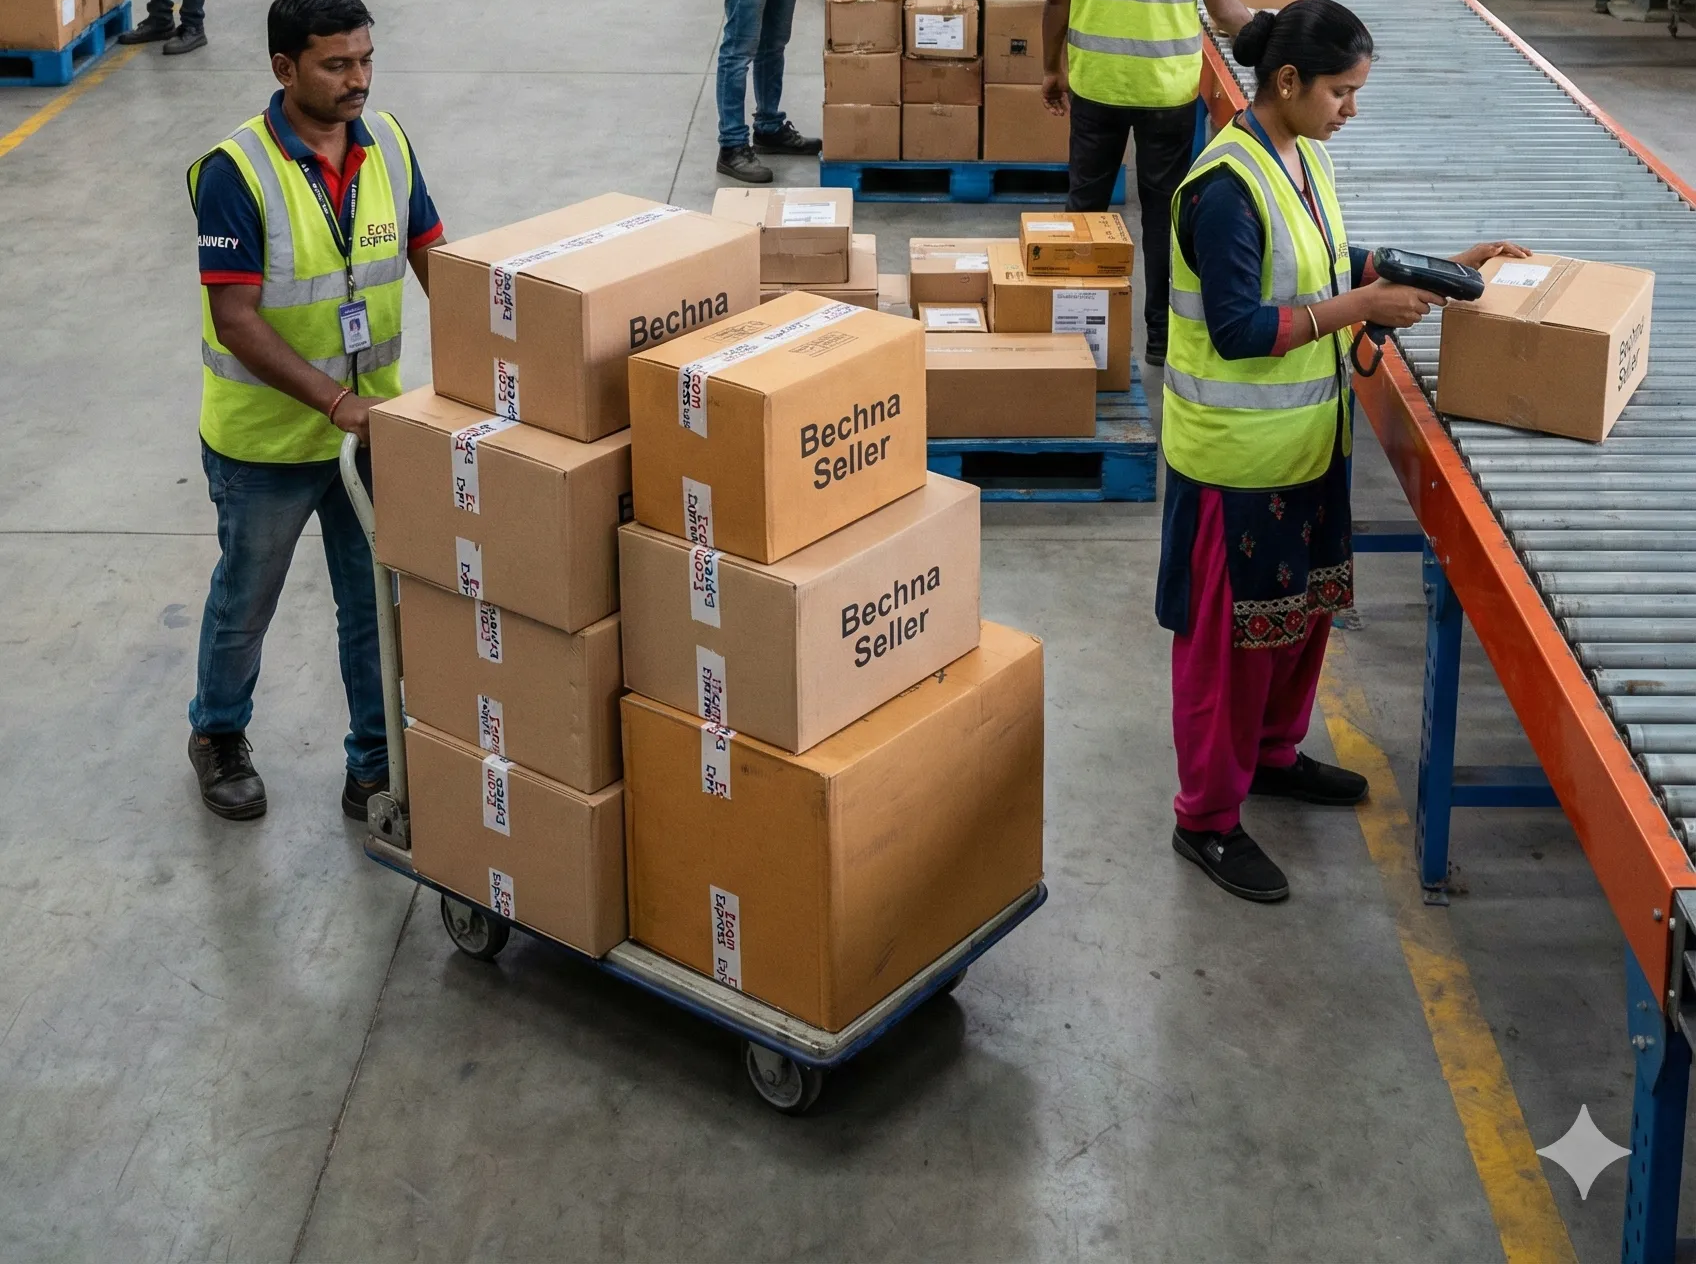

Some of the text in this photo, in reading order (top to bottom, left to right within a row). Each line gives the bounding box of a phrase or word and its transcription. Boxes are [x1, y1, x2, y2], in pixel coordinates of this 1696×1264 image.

[629, 291, 729, 350] Bechna
[800, 393, 902, 458] Bechna
[813, 432, 891, 491] Seller
[841, 566, 942, 639] Bechna
[853, 605, 930, 669] Seller
